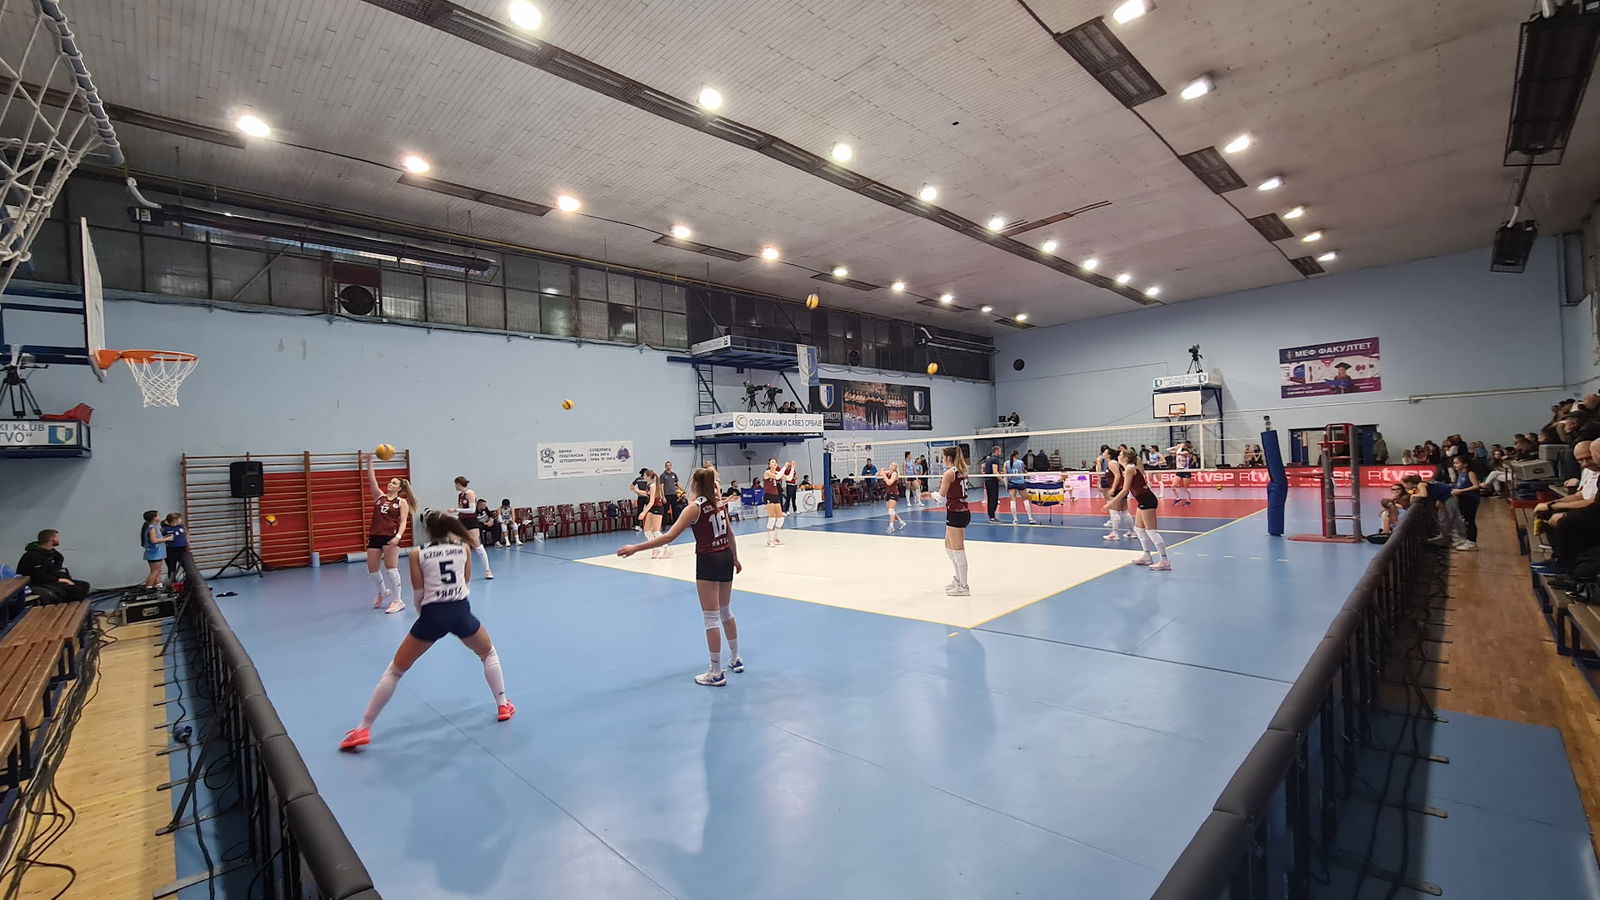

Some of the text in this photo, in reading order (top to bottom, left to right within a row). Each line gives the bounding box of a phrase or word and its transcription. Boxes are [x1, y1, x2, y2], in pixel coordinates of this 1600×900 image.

[1294, 342, 1372, 358] МЕФ ФАКУЛТЕТ
[13, 423, 45, 432] KLUB
[749, 418, 787, 428] ОДБОЈКАШКИ
[788, 419, 804, 427] САВЕЗ
[804, 419, 823, 427] СРБИЈЕ
[380, 505, 390, 514] 12
[708, 509, 727, 538] 16
[438, 560, 457, 584] 5
